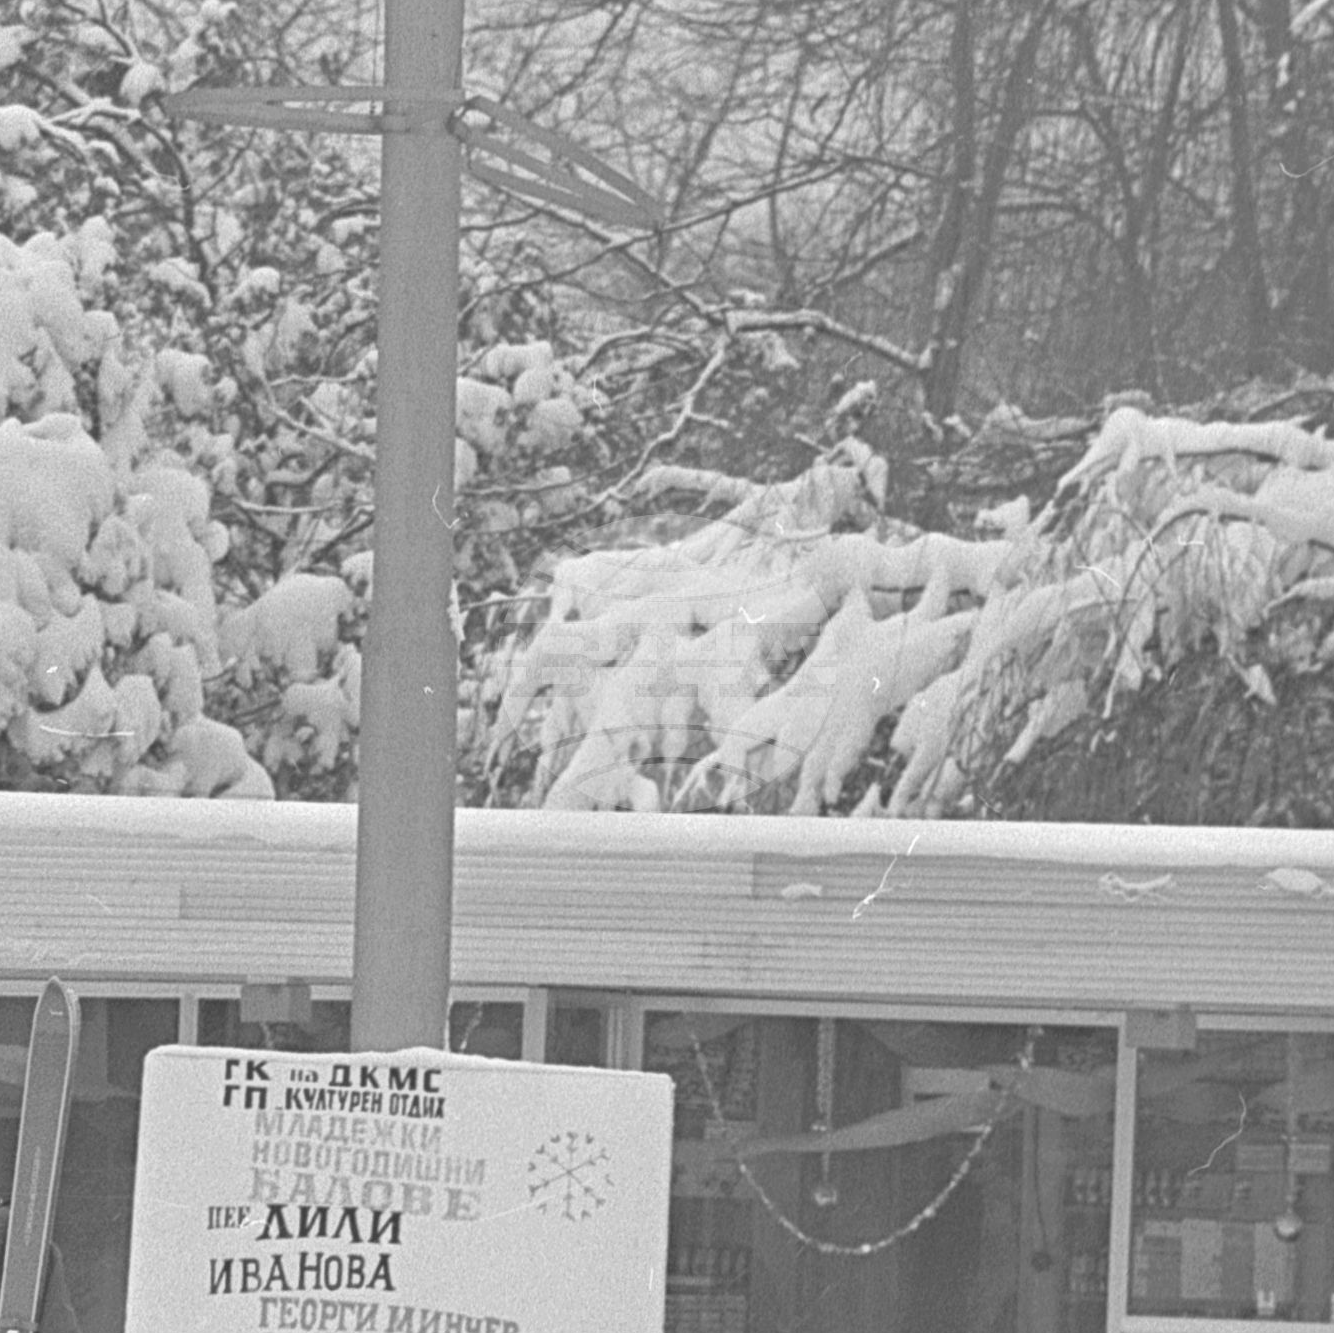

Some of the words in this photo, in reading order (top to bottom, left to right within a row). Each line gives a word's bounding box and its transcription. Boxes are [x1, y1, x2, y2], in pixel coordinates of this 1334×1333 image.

[224, 1058, 270, 1081] ГК
[328, 1064, 442, 1093] ДКМС
[223, 1084, 268, 1110] ГП
[285, 1087, 383, 1114] КУЛТУРЕН
[389, 1092, 446, 1119] ОТДИХ
[254, 1110, 442, 1154] МЛАДЕЖКИ
[252, 1139, 486, 1185] НОВОГОДИШНИ
[248, 1166, 482, 1222] БАЛОВЕ
[255, 1203, 403, 1245] ЛИЛИ
[209, 1251, 396, 1295] ИВАНОВА
[258, 1296, 380, 1333] ГЕОРГИ
